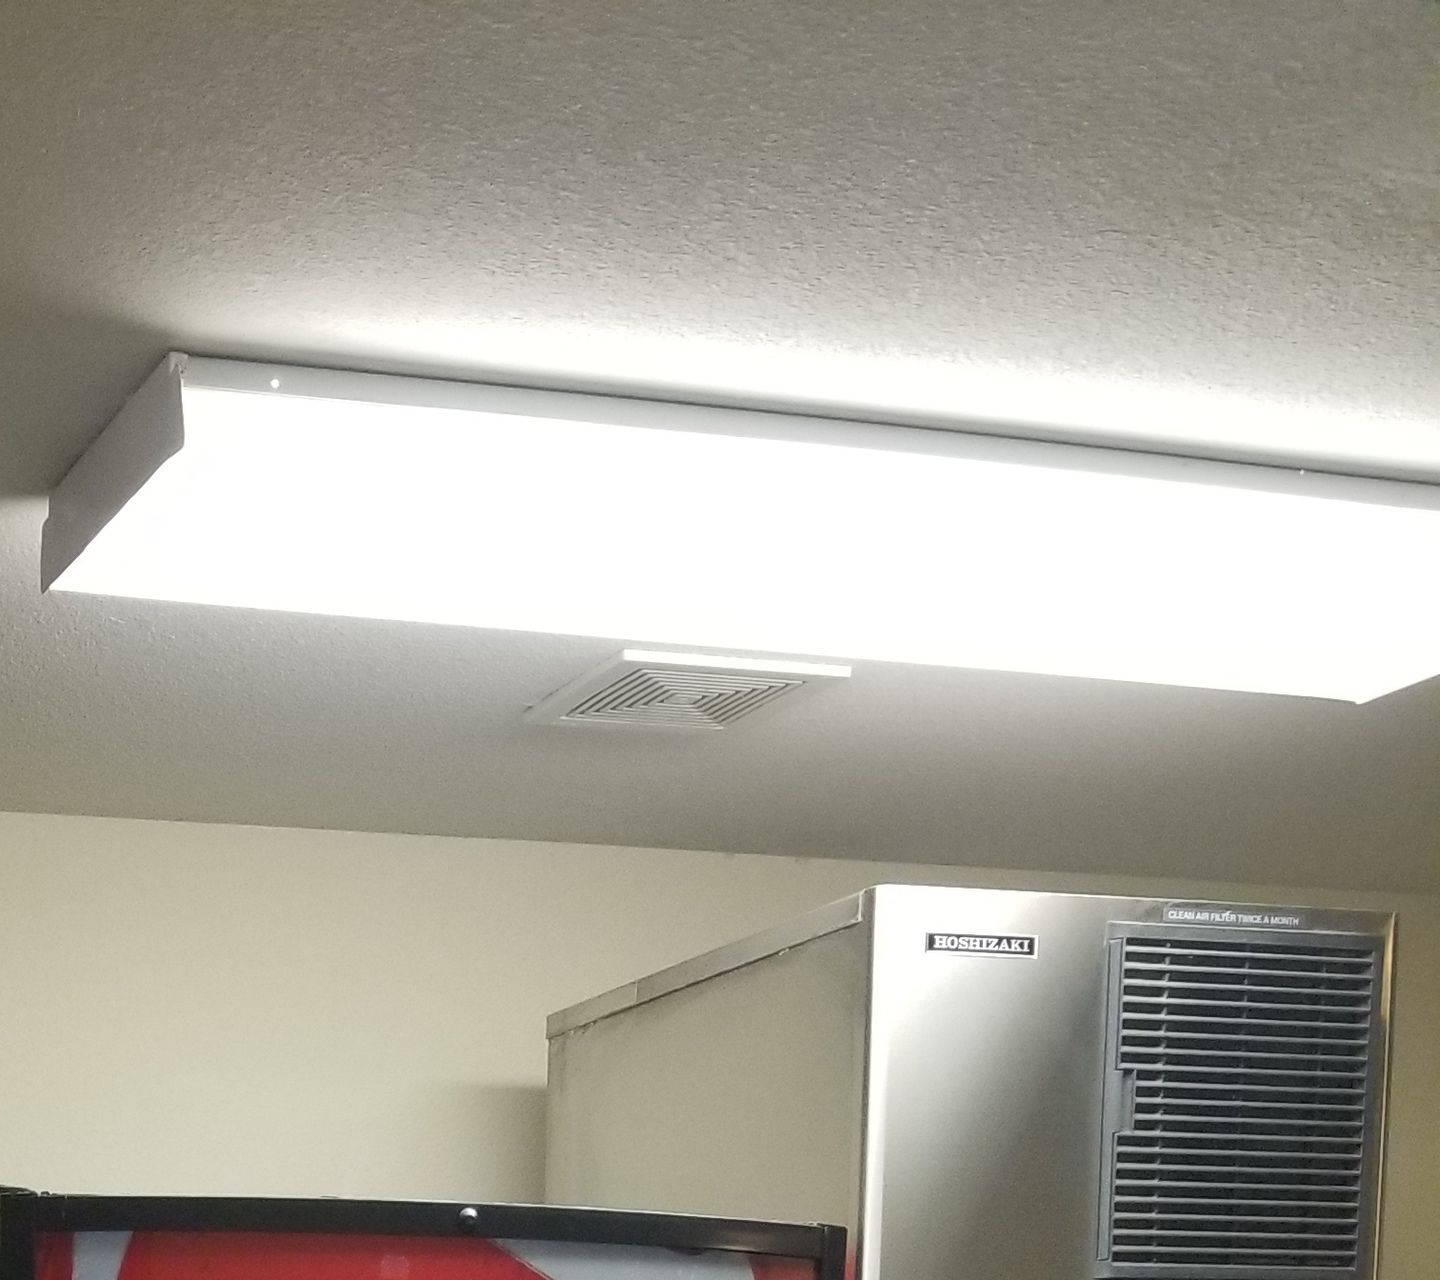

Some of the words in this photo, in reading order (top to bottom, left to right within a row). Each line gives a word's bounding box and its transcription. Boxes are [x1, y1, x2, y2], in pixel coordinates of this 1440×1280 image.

[1168, 910, 1195, 920] CLEAN
[1195, 911, 1209, 921] AIR
[1210, 911, 1237, 922] FILTER
[1237, 914, 1262, 924] TWICE
[1270, 915, 1300, 926] MONTH
[933, 934, 1031, 952] HOSHIZAKI
